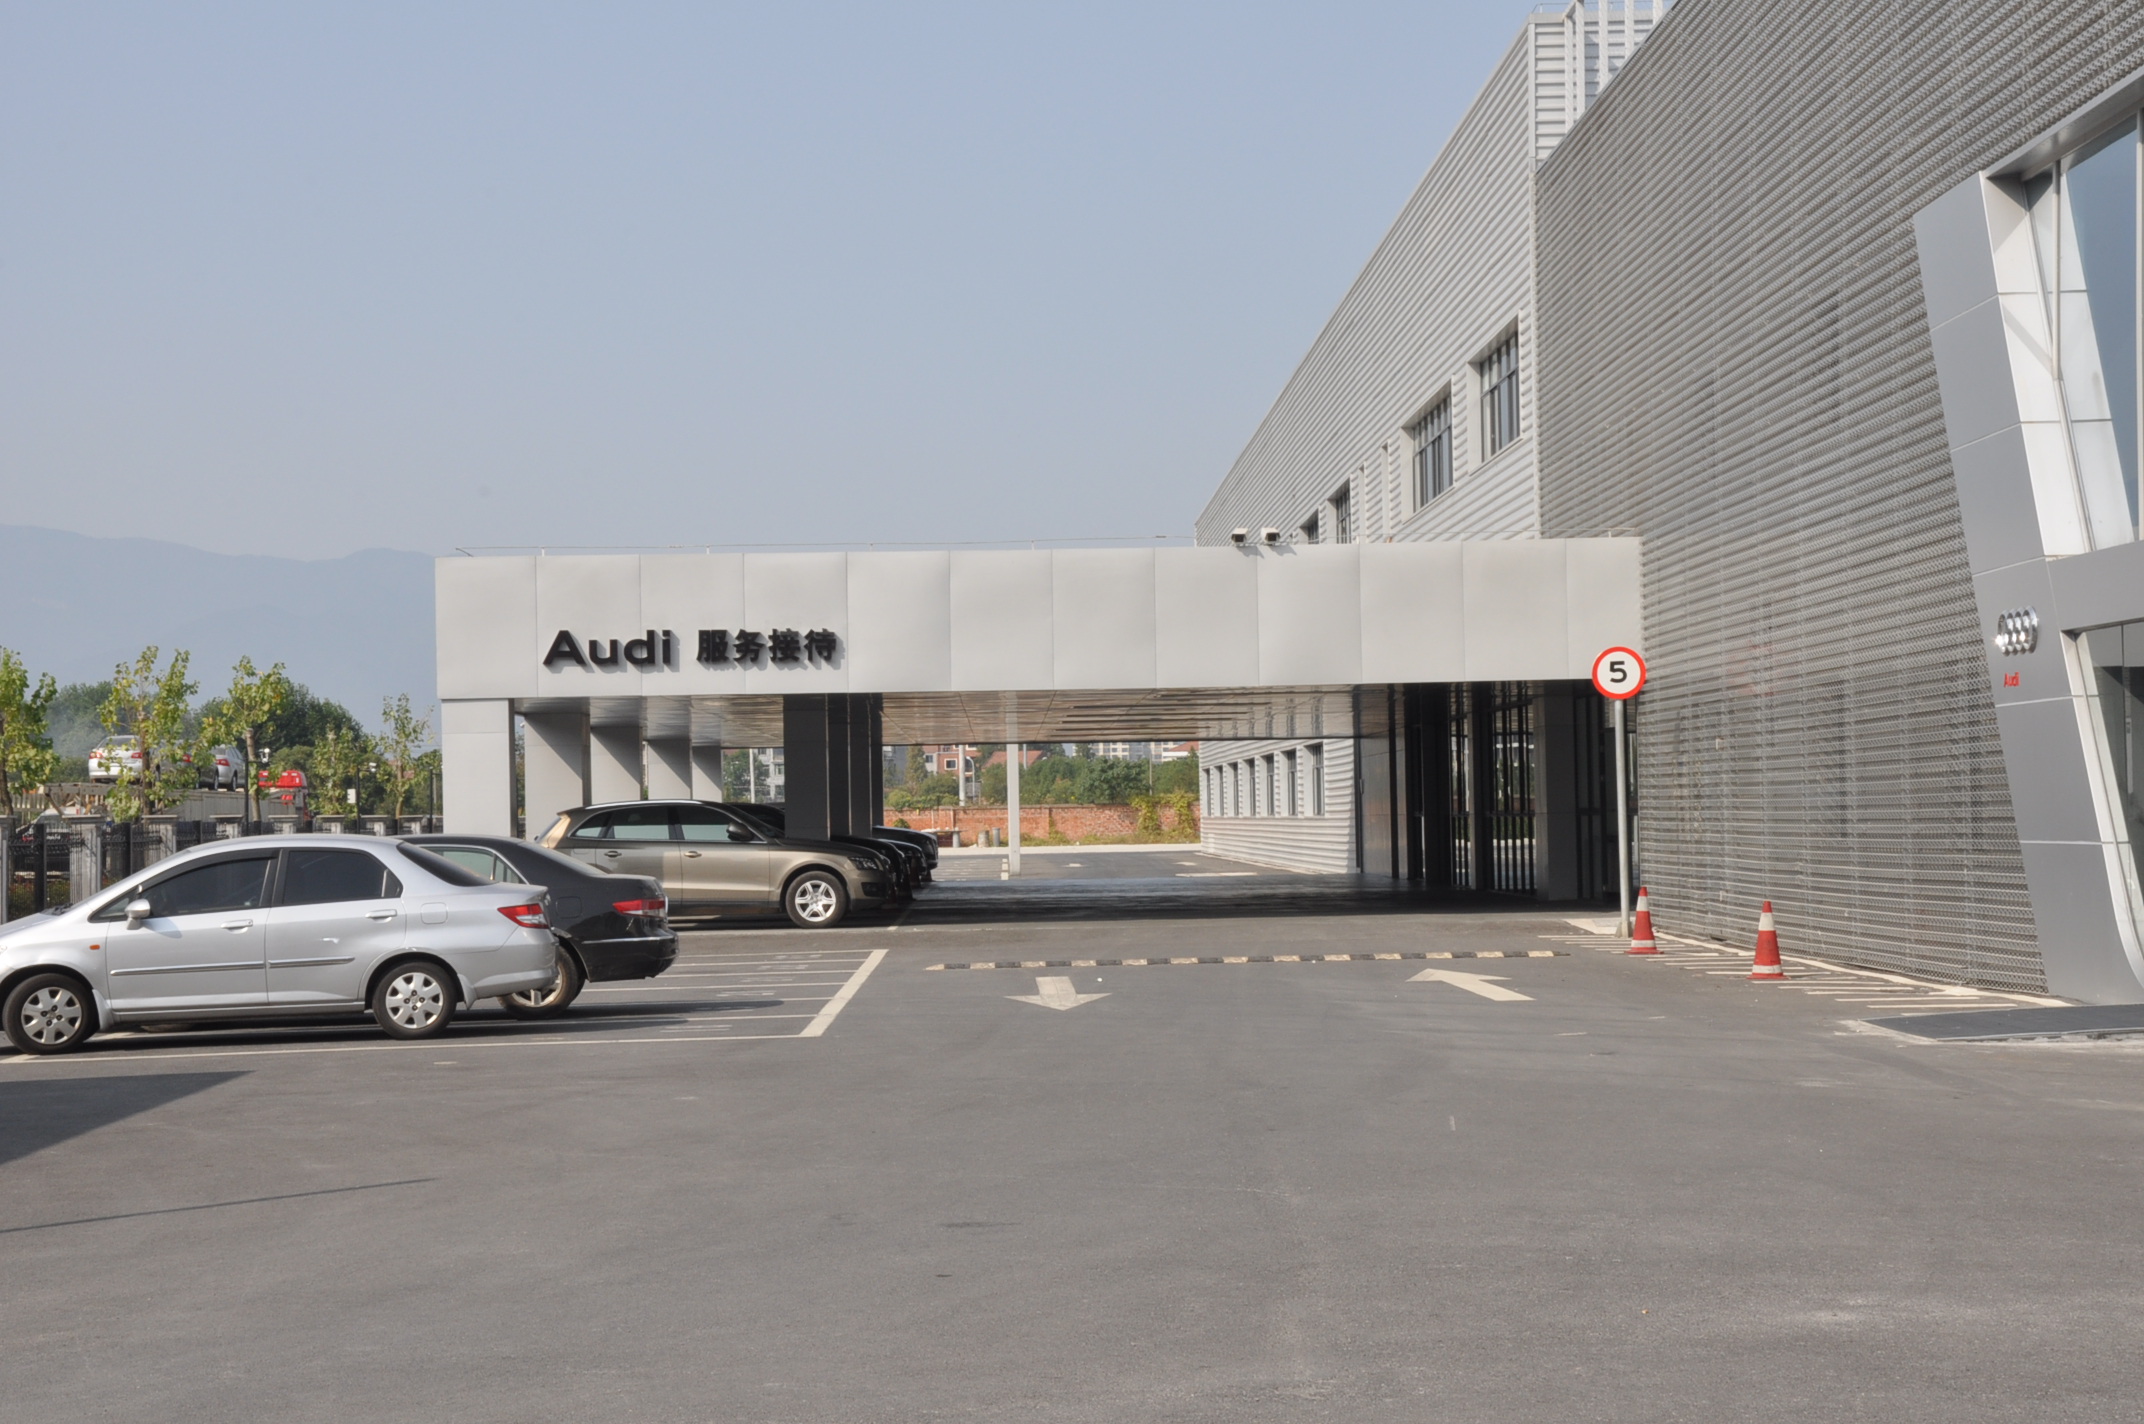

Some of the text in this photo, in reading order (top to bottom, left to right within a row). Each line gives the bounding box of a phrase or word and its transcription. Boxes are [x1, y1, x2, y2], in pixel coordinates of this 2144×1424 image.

[542, 629, 672, 665] Audi
[696, 628, 839, 664] 服务接待
[1609, 660, 1628, 683] 5
